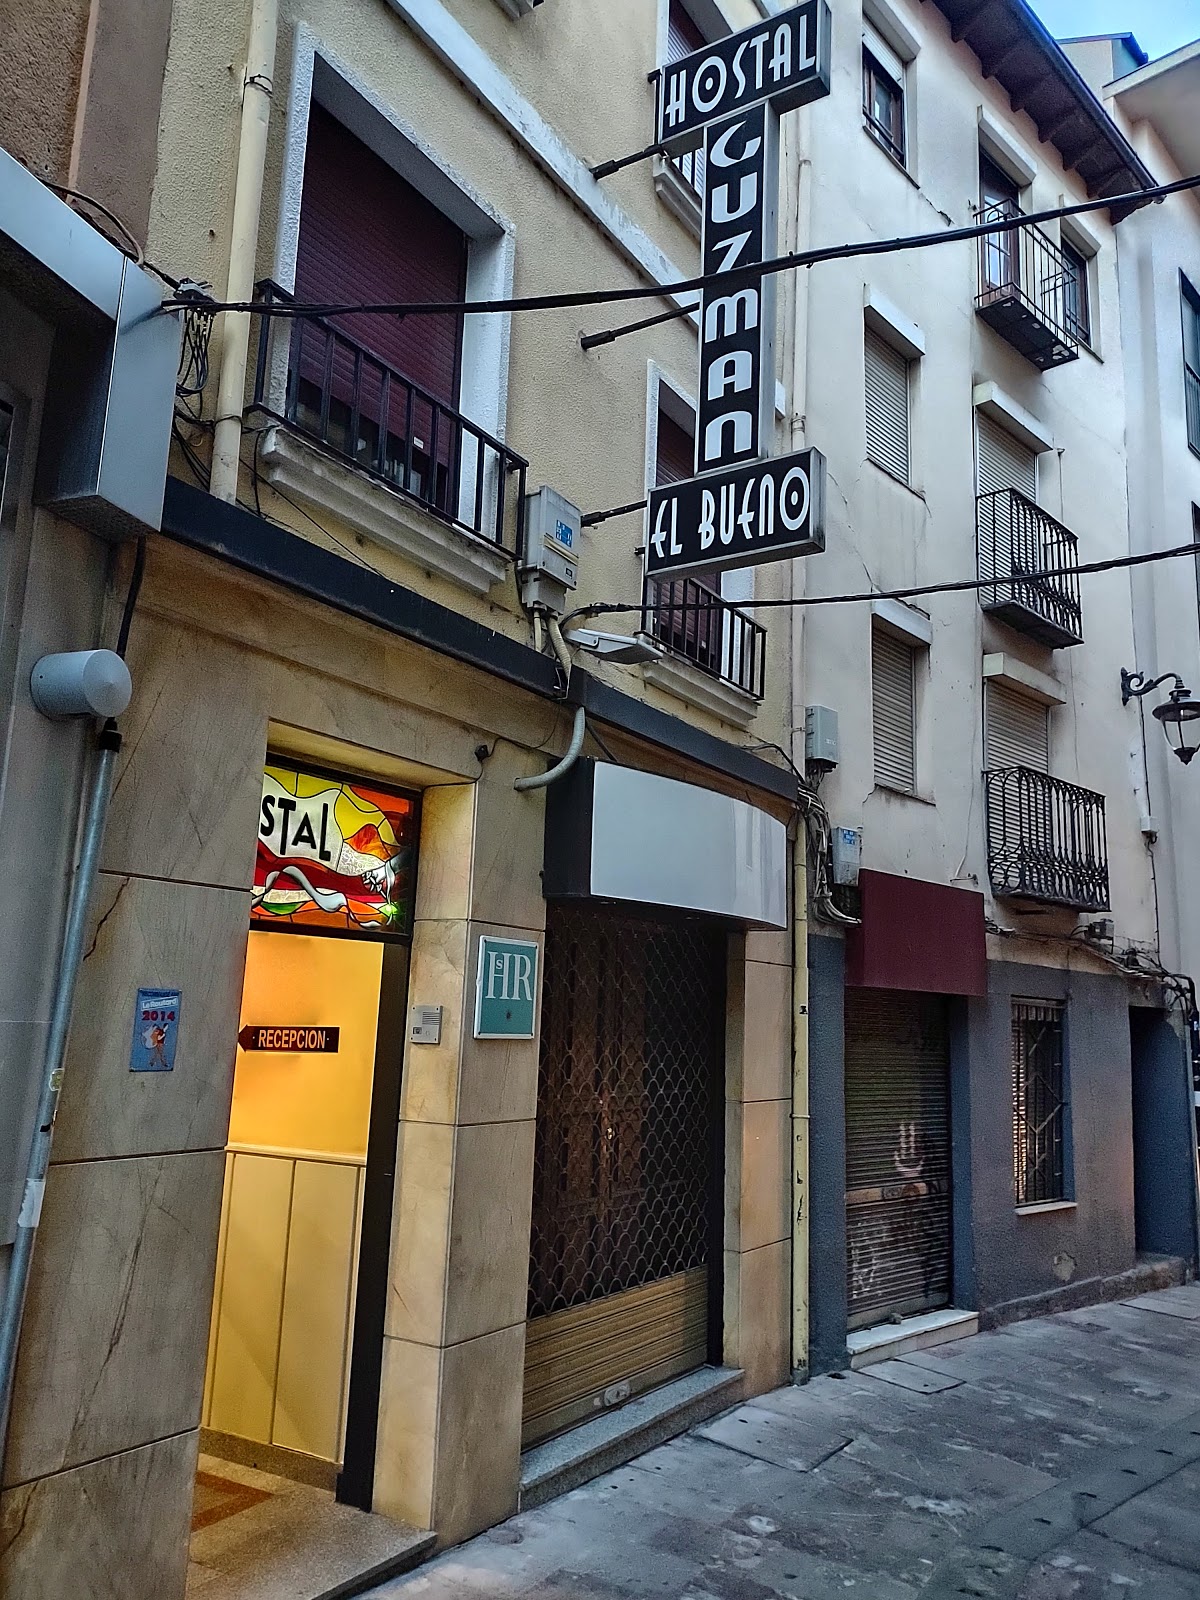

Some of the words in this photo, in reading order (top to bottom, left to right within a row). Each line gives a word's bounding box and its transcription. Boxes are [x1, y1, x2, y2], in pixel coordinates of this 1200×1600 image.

[665, 14, 816, 128] HOSTAL
[705, 120, 762, 462] GUZMAN
[651, 497, 683, 558] EL
[698, 466, 810, 550] BUENO
[141, 1010, 176, 1022] 2014
[142, 1001, 150, 1009] Le
[258, 1029, 326, 1049] RECEPCION
